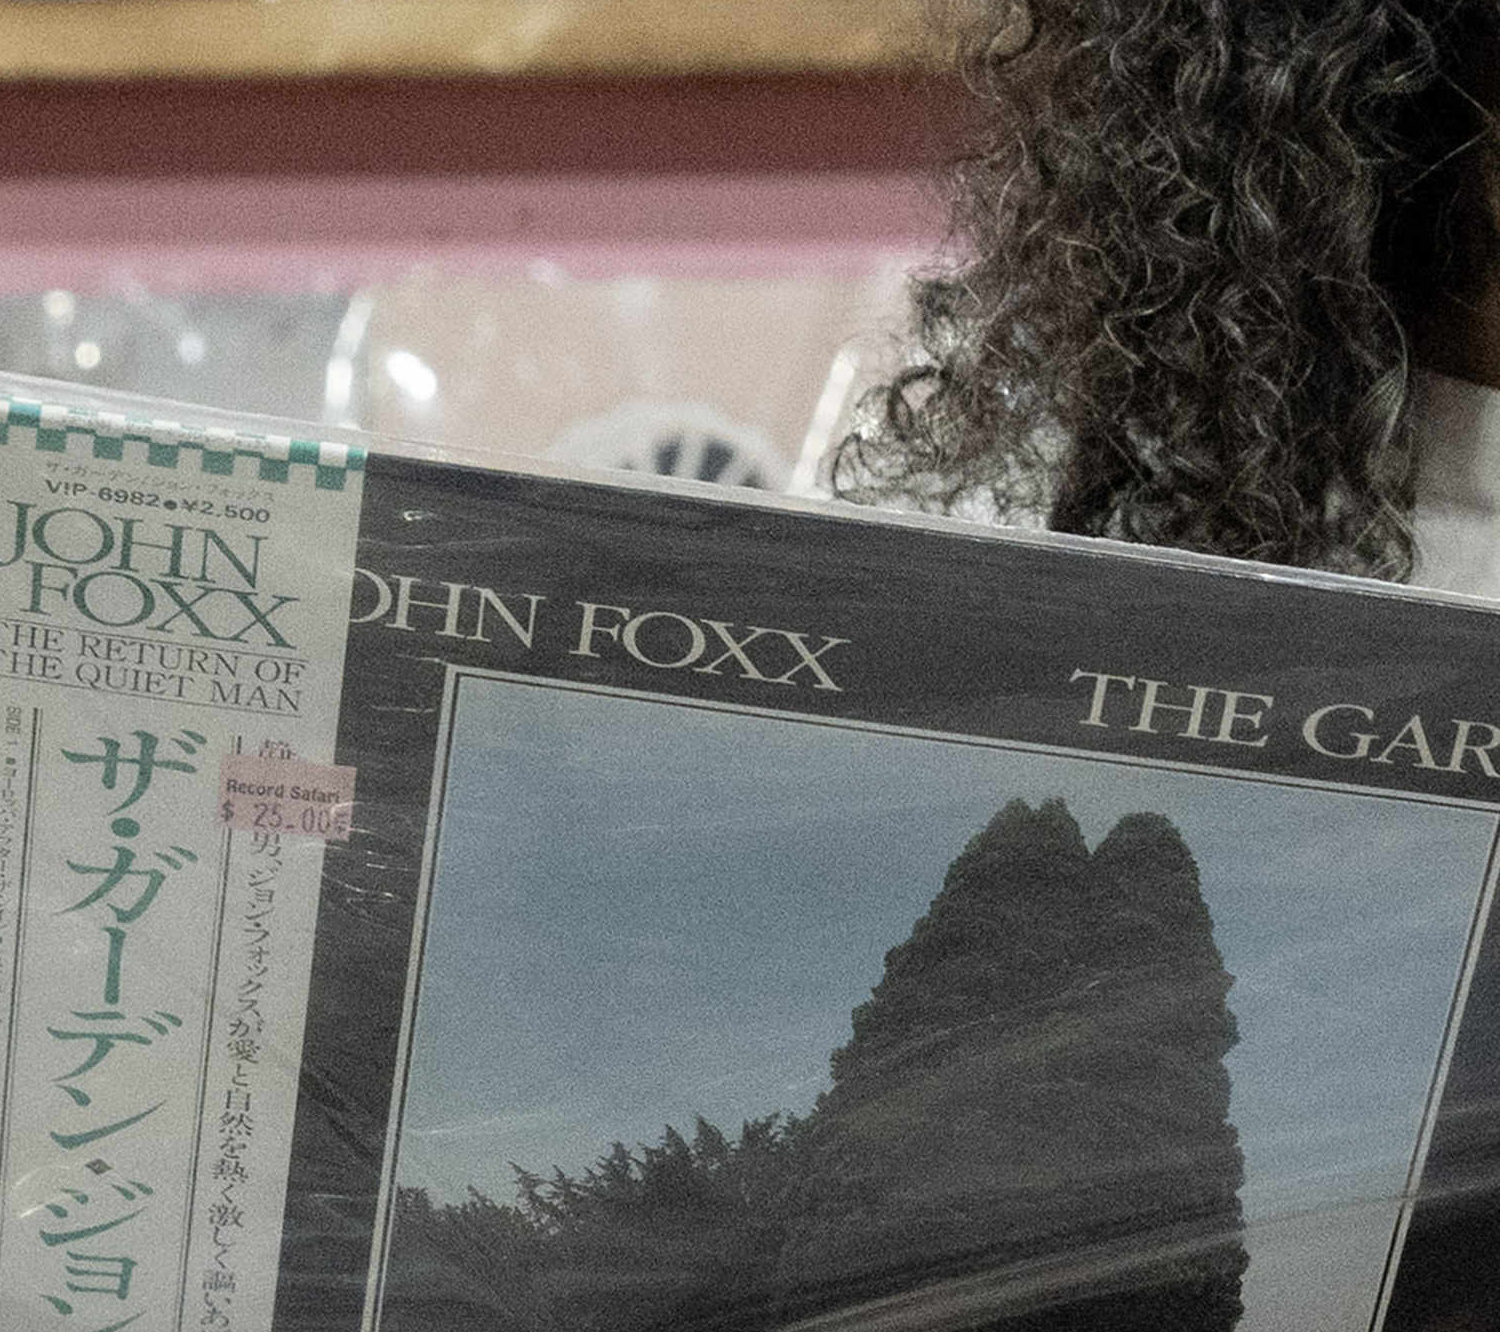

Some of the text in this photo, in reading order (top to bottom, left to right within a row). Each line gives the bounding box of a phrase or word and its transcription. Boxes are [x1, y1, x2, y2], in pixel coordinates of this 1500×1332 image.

[19, 560, 301, 650] FOXX
[349, 567, 853, 693] OHN FOXX
[75, 663, 197, 701] QUIET
[210, 680, 302, 713] MAN
[79, 634, 240, 679] RETURN
[255, 659, 306, 687] OF
[1069, 667, 1276, 749] THE
[226, 777, 340, 804] Record Safari
[47, 729, 208, 1152] ザ・ガーデン
